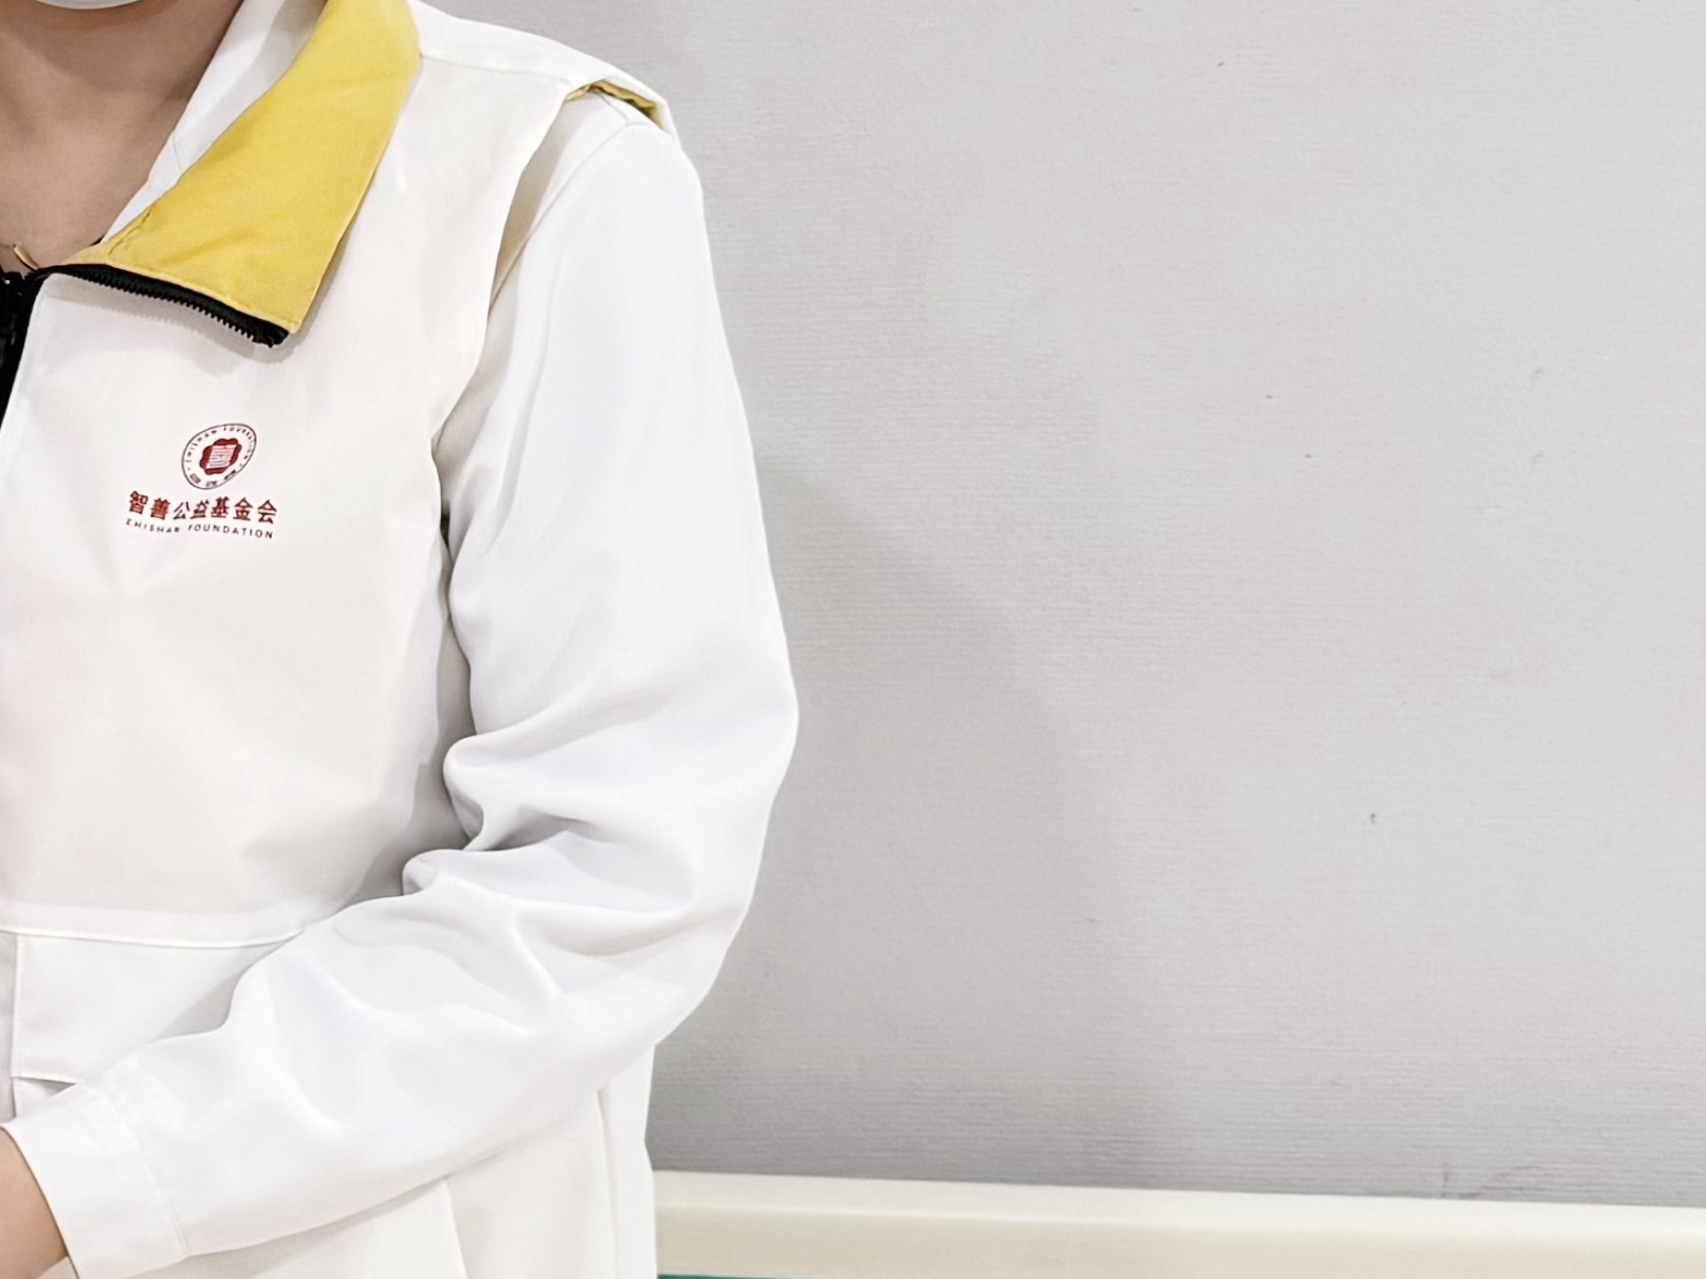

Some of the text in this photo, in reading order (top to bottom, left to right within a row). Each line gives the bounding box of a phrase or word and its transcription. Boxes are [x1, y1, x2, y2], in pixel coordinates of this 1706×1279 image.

[129, 491, 277, 524] 智善公益基金会
